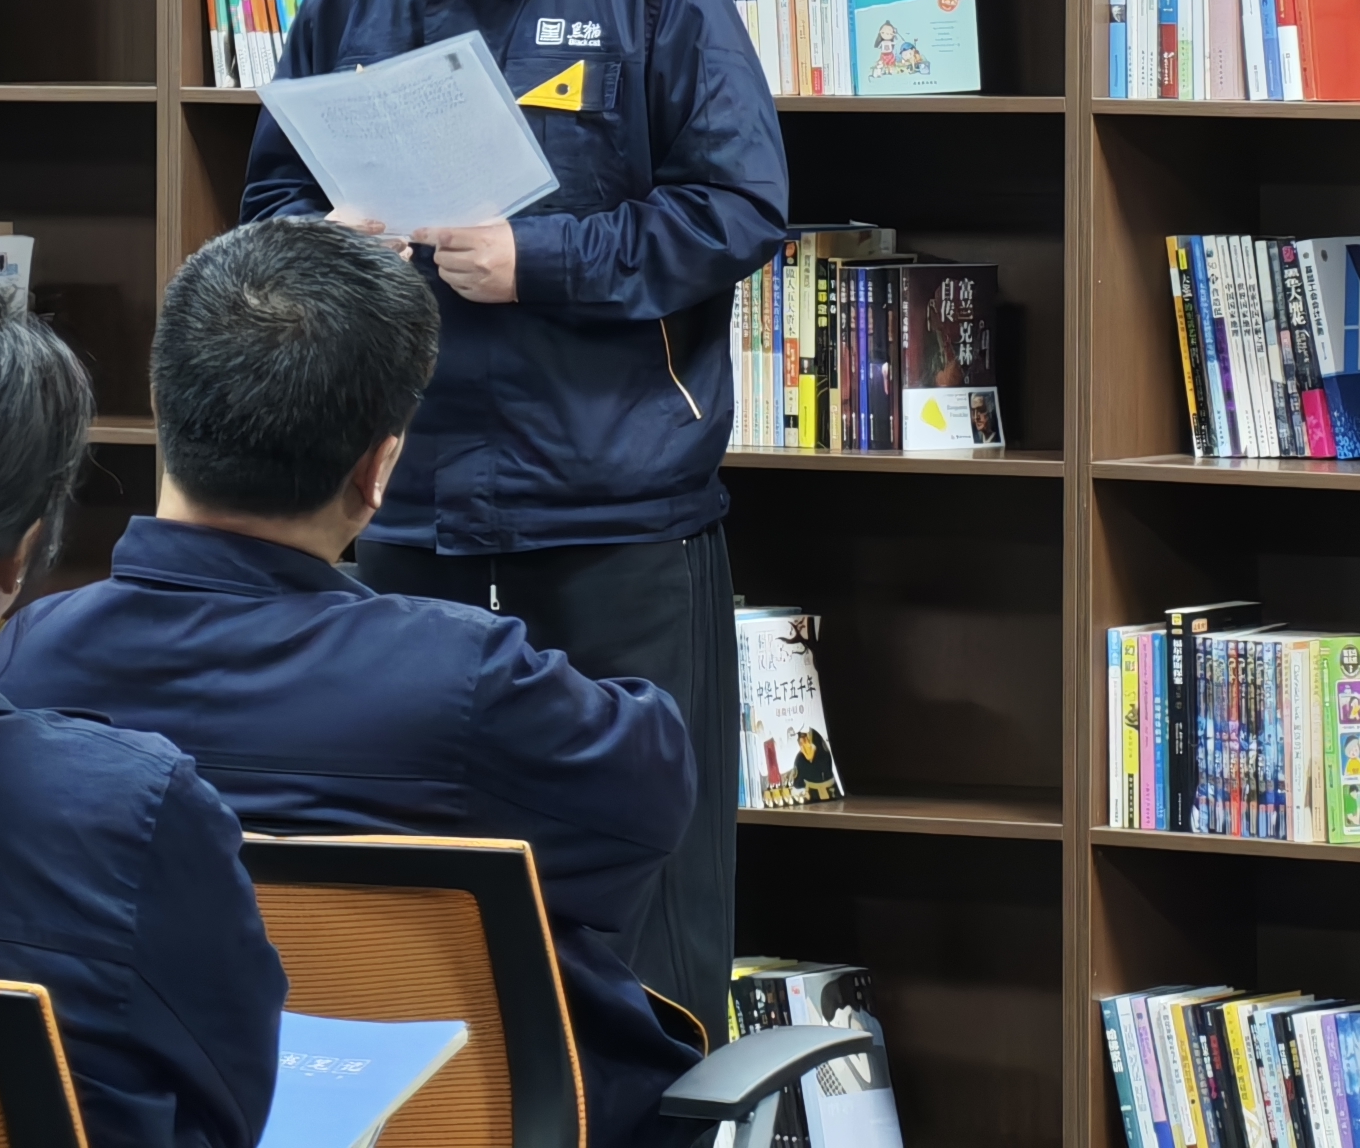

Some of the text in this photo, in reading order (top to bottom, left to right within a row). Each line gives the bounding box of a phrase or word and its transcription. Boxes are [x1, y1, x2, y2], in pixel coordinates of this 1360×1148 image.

[940, 278, 956, 324] 自传
[957, 277, 976, 367] 富兰克林
[756, 674, 817, 708] 中华上下五千年
